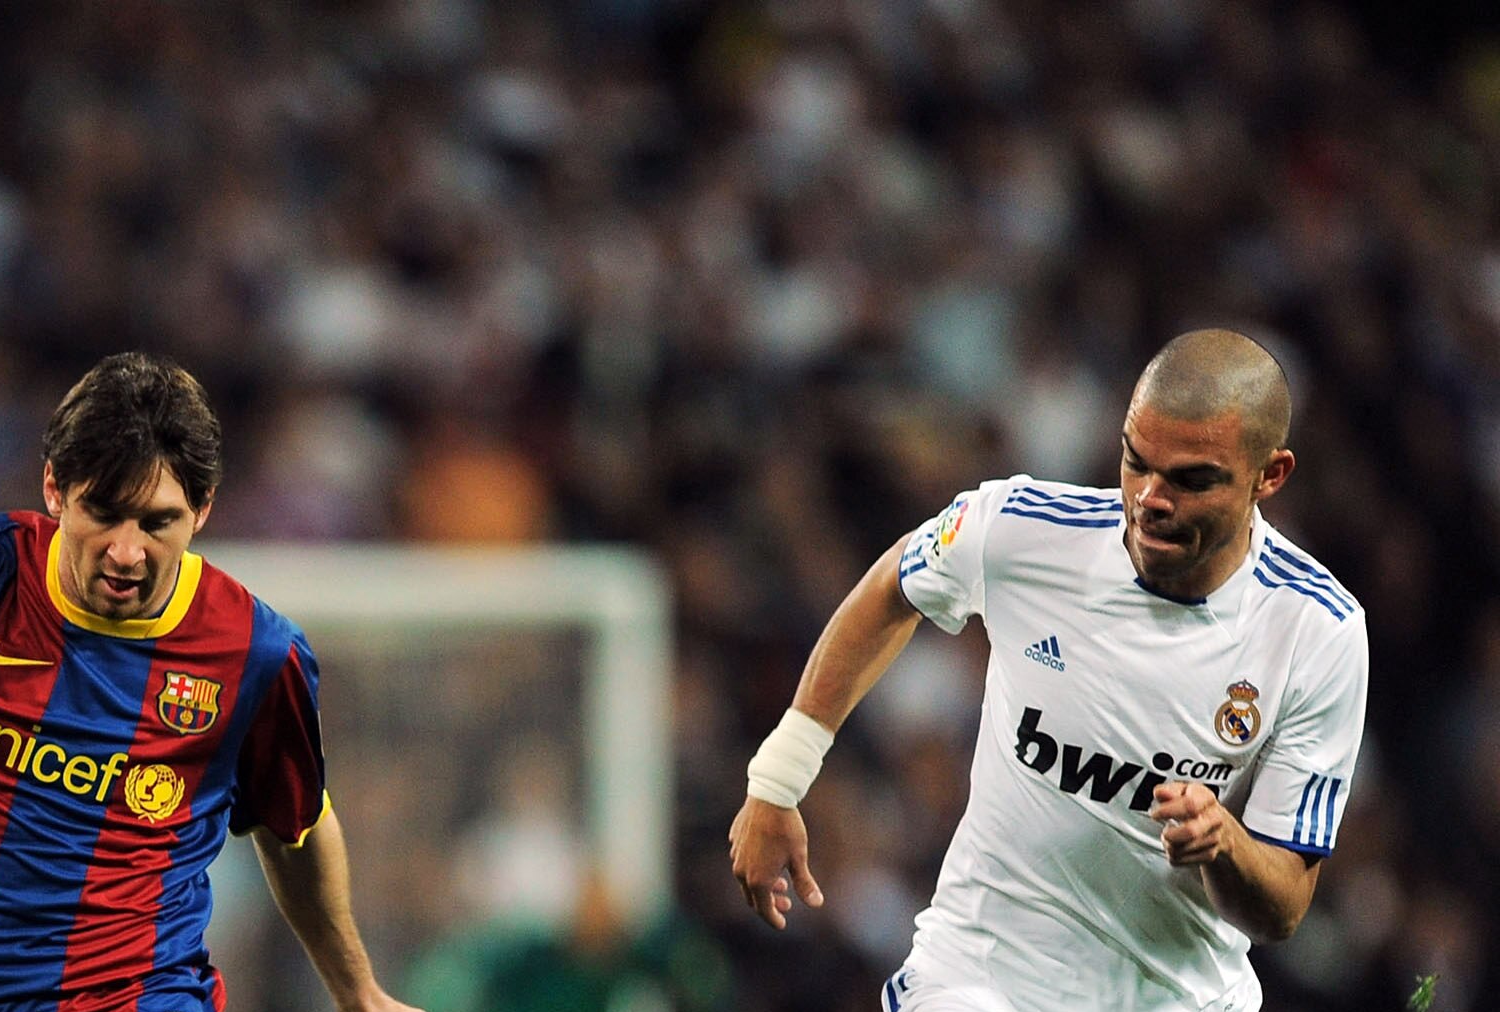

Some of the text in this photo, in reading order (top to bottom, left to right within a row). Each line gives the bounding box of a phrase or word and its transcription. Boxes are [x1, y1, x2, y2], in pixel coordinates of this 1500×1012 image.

[1024, 647, 1066, 672] adidas
[1014, 706, 1234, 813] bwi com
